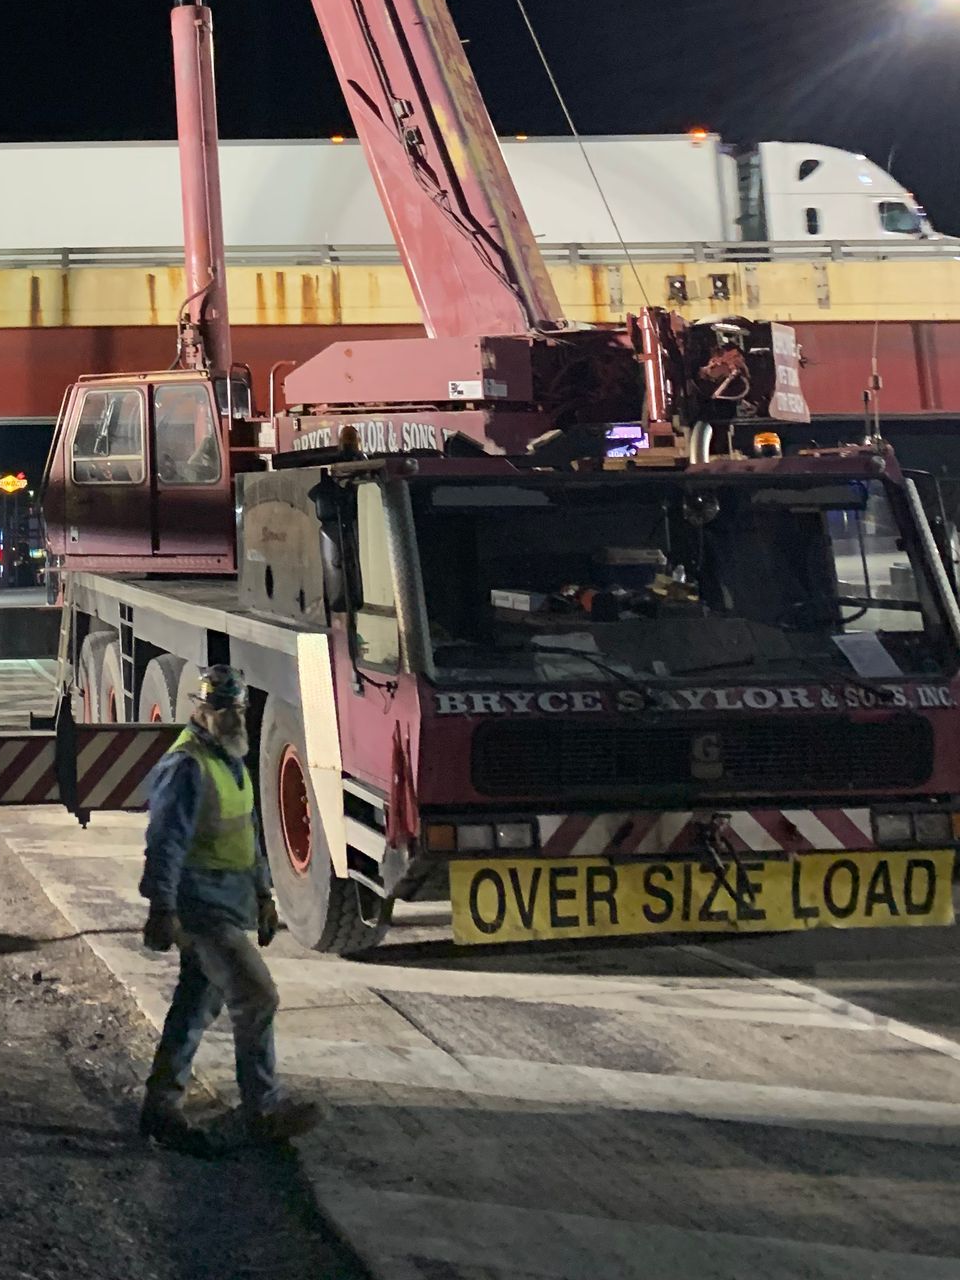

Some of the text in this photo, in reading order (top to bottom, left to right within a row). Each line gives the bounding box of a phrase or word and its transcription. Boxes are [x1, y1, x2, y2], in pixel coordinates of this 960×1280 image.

[388, 421, 398, 452] &
[435, 691, 603, 714] BRYCE
[821, 686, 839, 708] &
[468, 857, 938, 936] OVER SIZE LOAD
